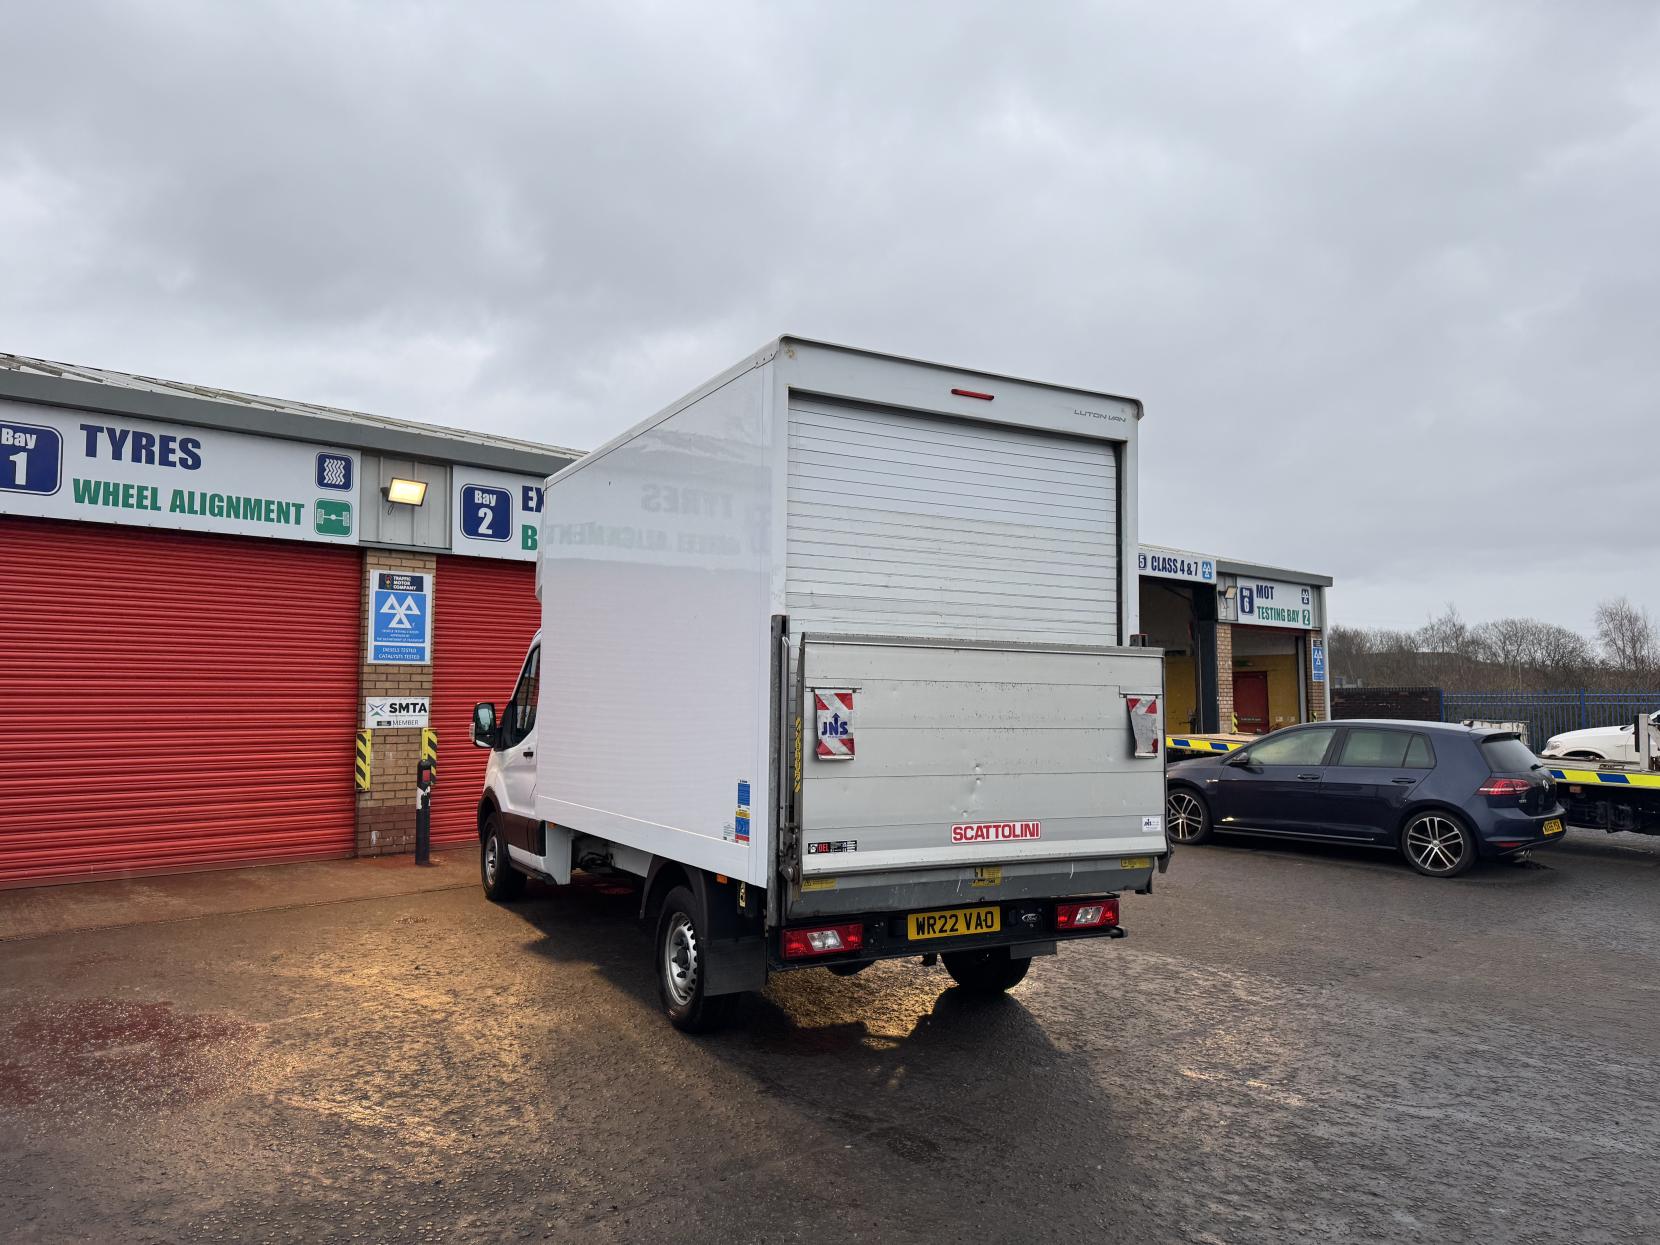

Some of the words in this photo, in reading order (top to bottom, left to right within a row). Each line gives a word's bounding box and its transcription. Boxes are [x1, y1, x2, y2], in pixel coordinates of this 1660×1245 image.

[1074, 409, 1107, 419] LUTON
[1, 427, 37, 449] Bay
[79, 423, 202, 471] TYRES
[9, 451, 29, 485] 1
[72, 478, 162, 511] WHEEL
[169, 489, 305, 525] ALIGNMENT
[474, 490, 497, 507] Bay
[478, 507, 493, 534] 2
[1151, 555, 1178, 574] CLASS
[1180, 560, 1185, 574] 4
[1187, 563, 1192, 575] &
[1193, 562, 1198, 576] 7
[1256, 584, 1274, 600] MOT
[1243, 598, 1250, 612] 6
[1256, 606, 1286, 622] TESTING
[1287, 609, 1300, 623] BAY
[1303, 610, 1309, 624] 2
[389, 702, 428, 713] SMTA
[821, 719, 849, 735] JNS
[952, 822, 1040, 841] SCATTOLINI
[915, 914, 959, 936] WR22
[964, 910, 994, 931] VAO
